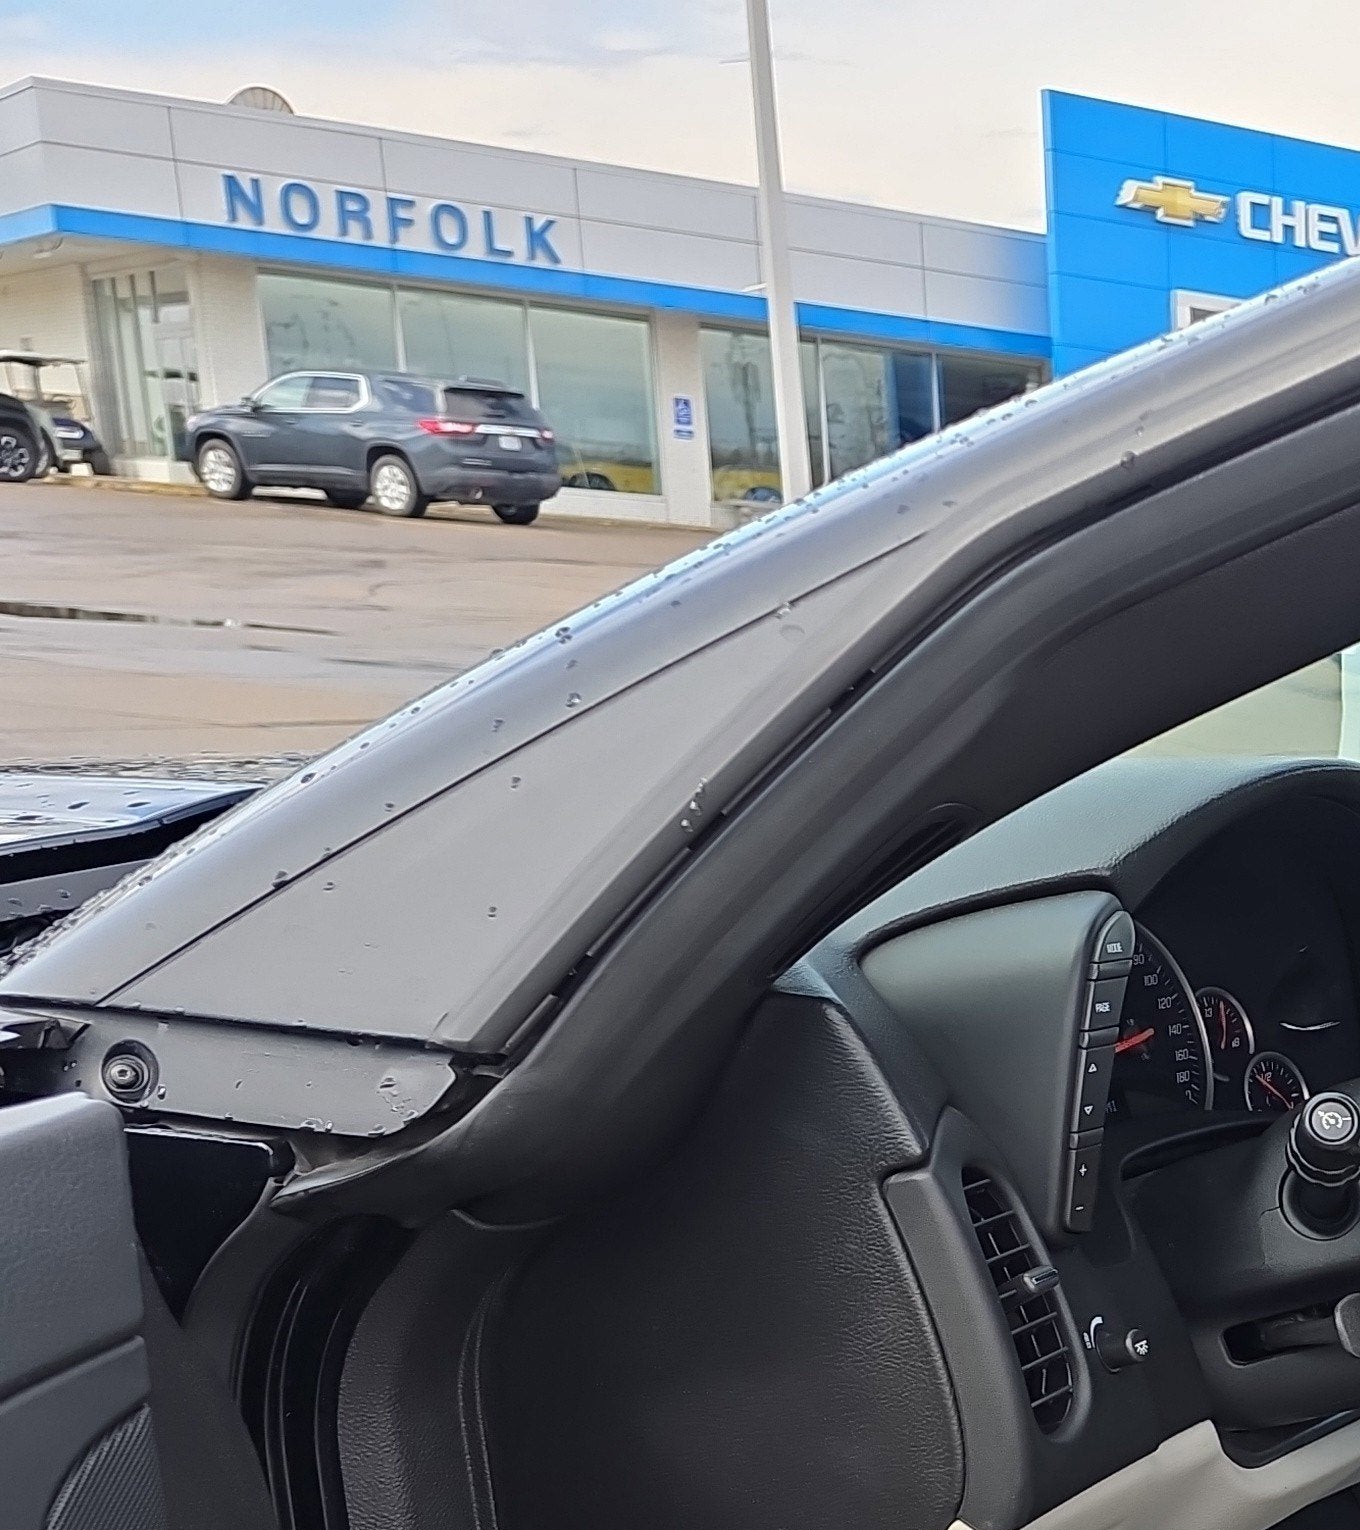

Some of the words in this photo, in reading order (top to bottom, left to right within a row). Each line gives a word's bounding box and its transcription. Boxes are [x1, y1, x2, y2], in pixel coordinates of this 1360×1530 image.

[221, 173, 562, 265] NORFOLK
[1143, 973, 1159, 987] 100
[1157, 996, 1172, 1010] 120
[1168, 1024, 1182, 1037] 140
[1175, 1049, 1190, 1062] 160
[1176, 1070, 1190, 1084] 180
